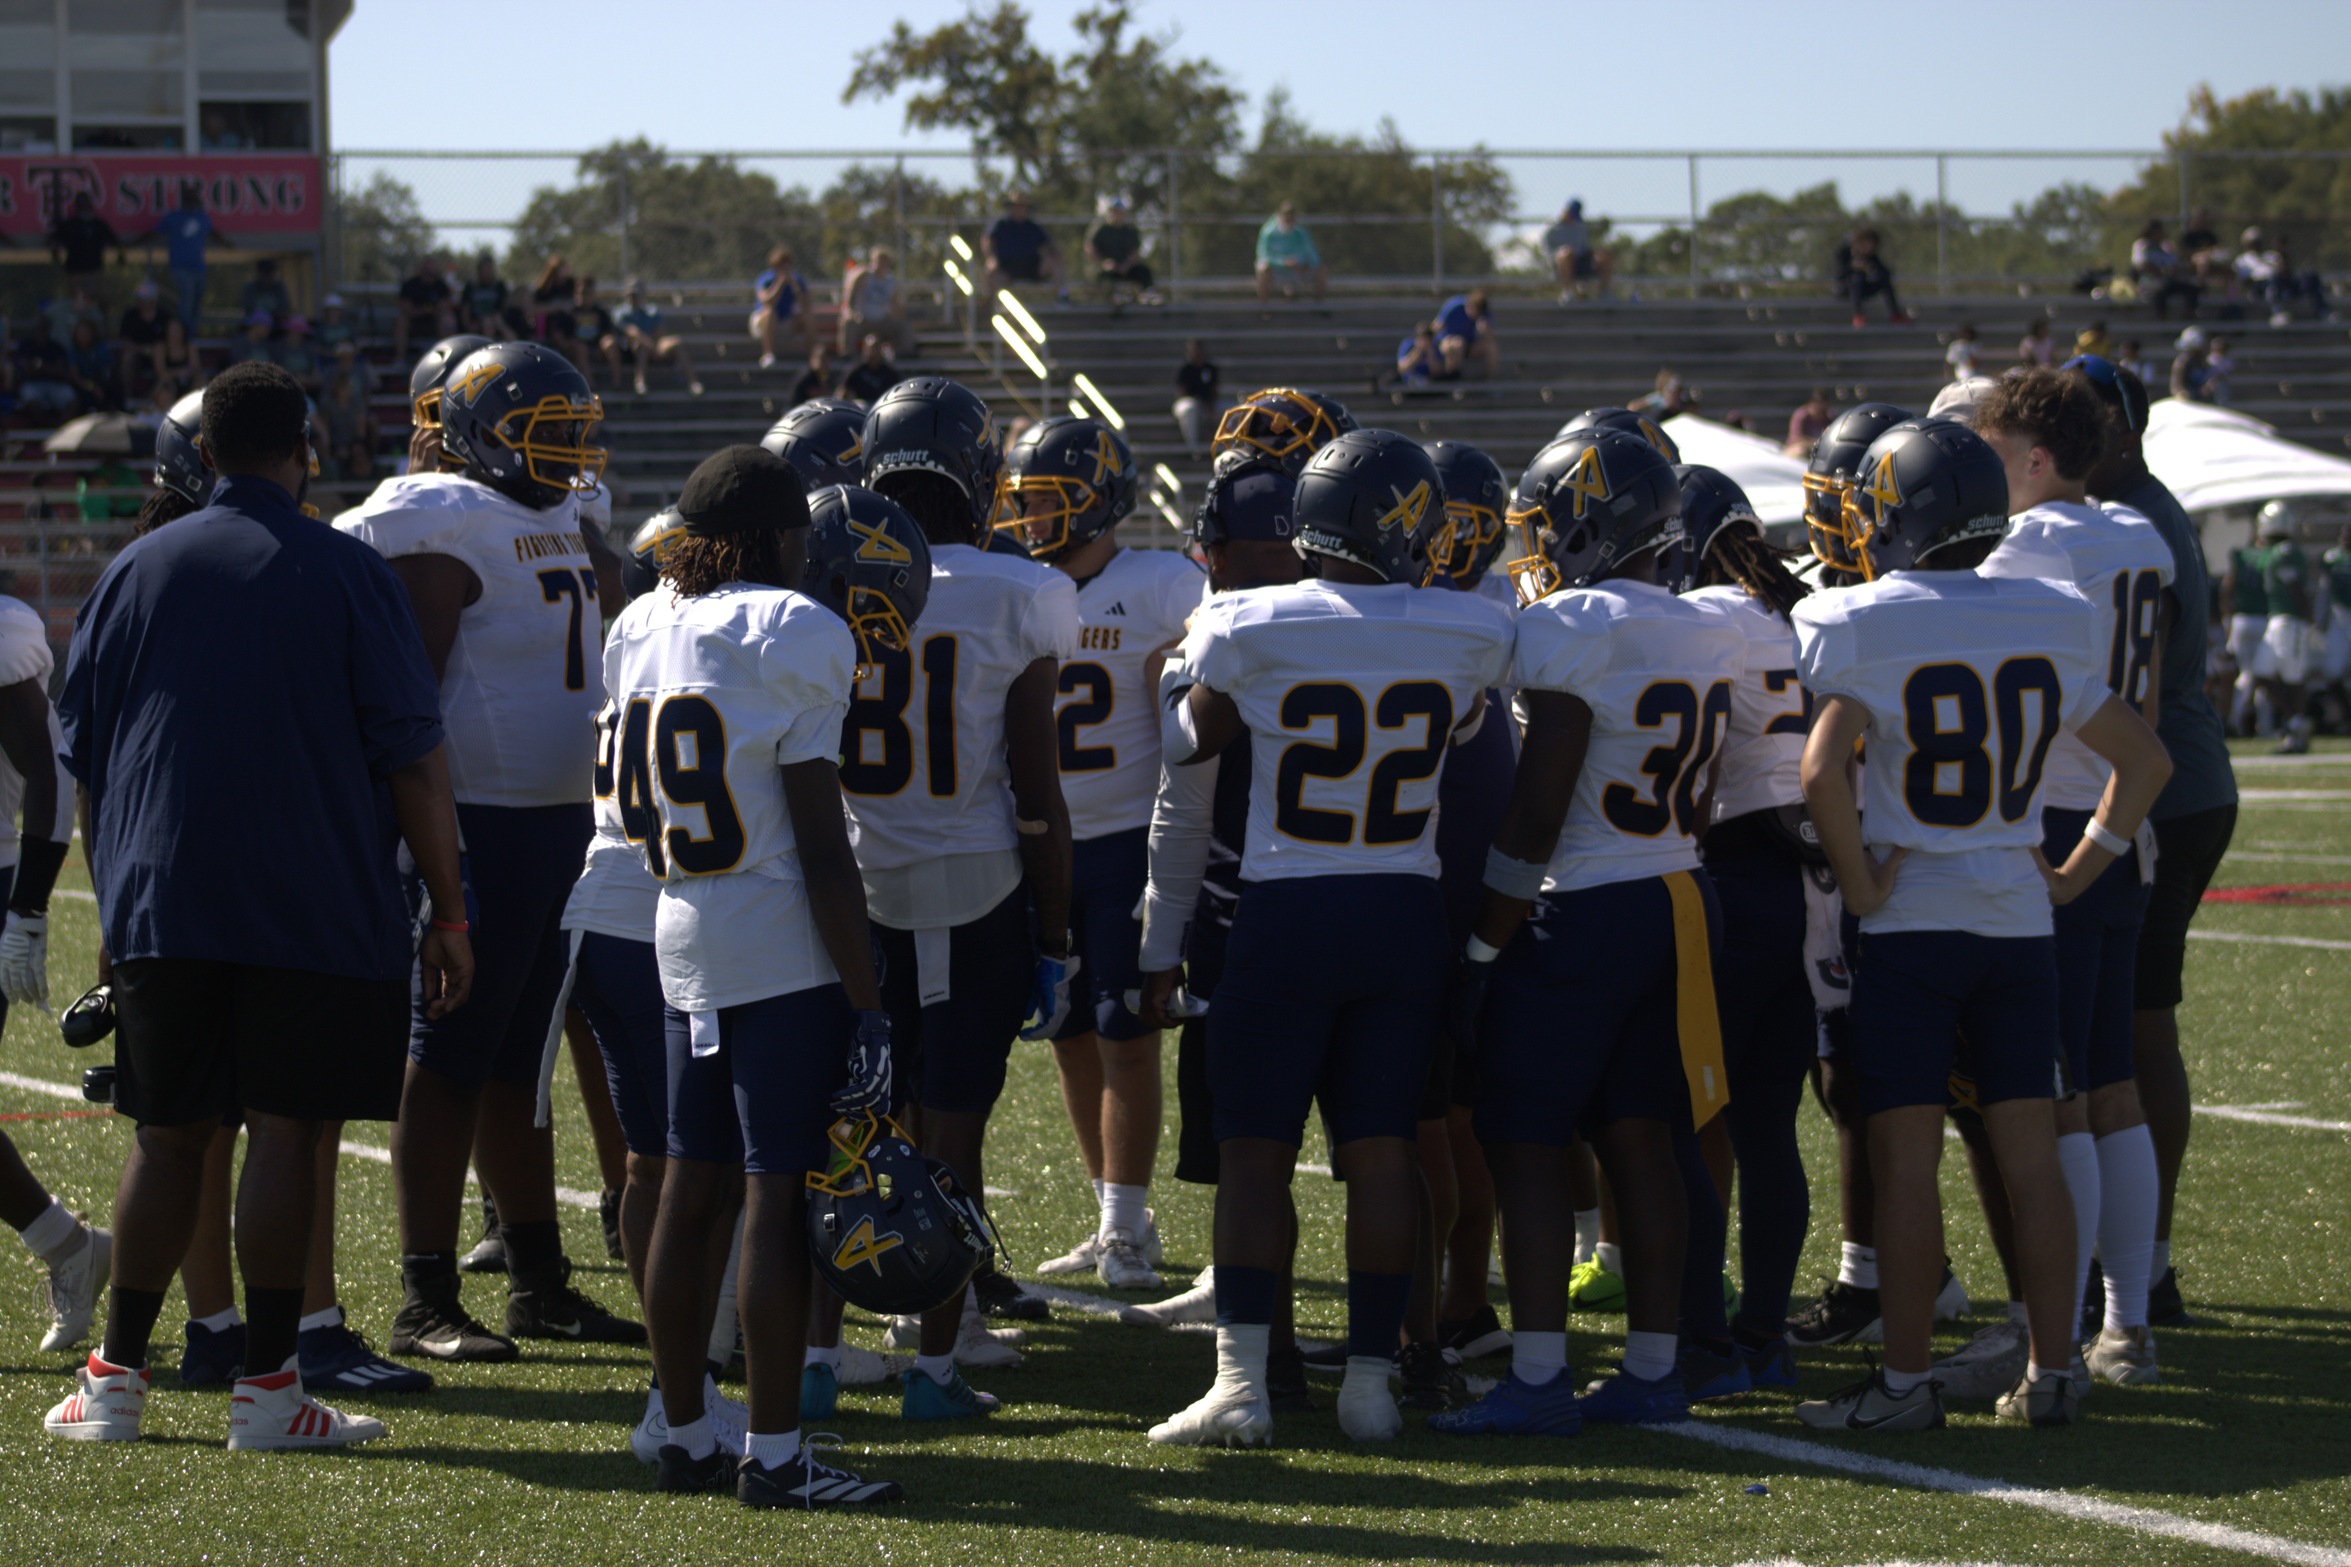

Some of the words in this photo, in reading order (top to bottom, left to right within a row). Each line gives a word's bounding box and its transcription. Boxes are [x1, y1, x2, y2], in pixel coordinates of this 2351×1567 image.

[882, 447, 929, 465] schutt
[1301, 528, 1343, 549] schutt
[838, 632, 959, 799] 81
[2107, 567, 2160, 718] 18
[618, 693, 748, 880] 49
[1275, 679, 1455, 847] 22
[1600, 678, 1733, 840] 30
[1902, 654, 2062, 830] 80
